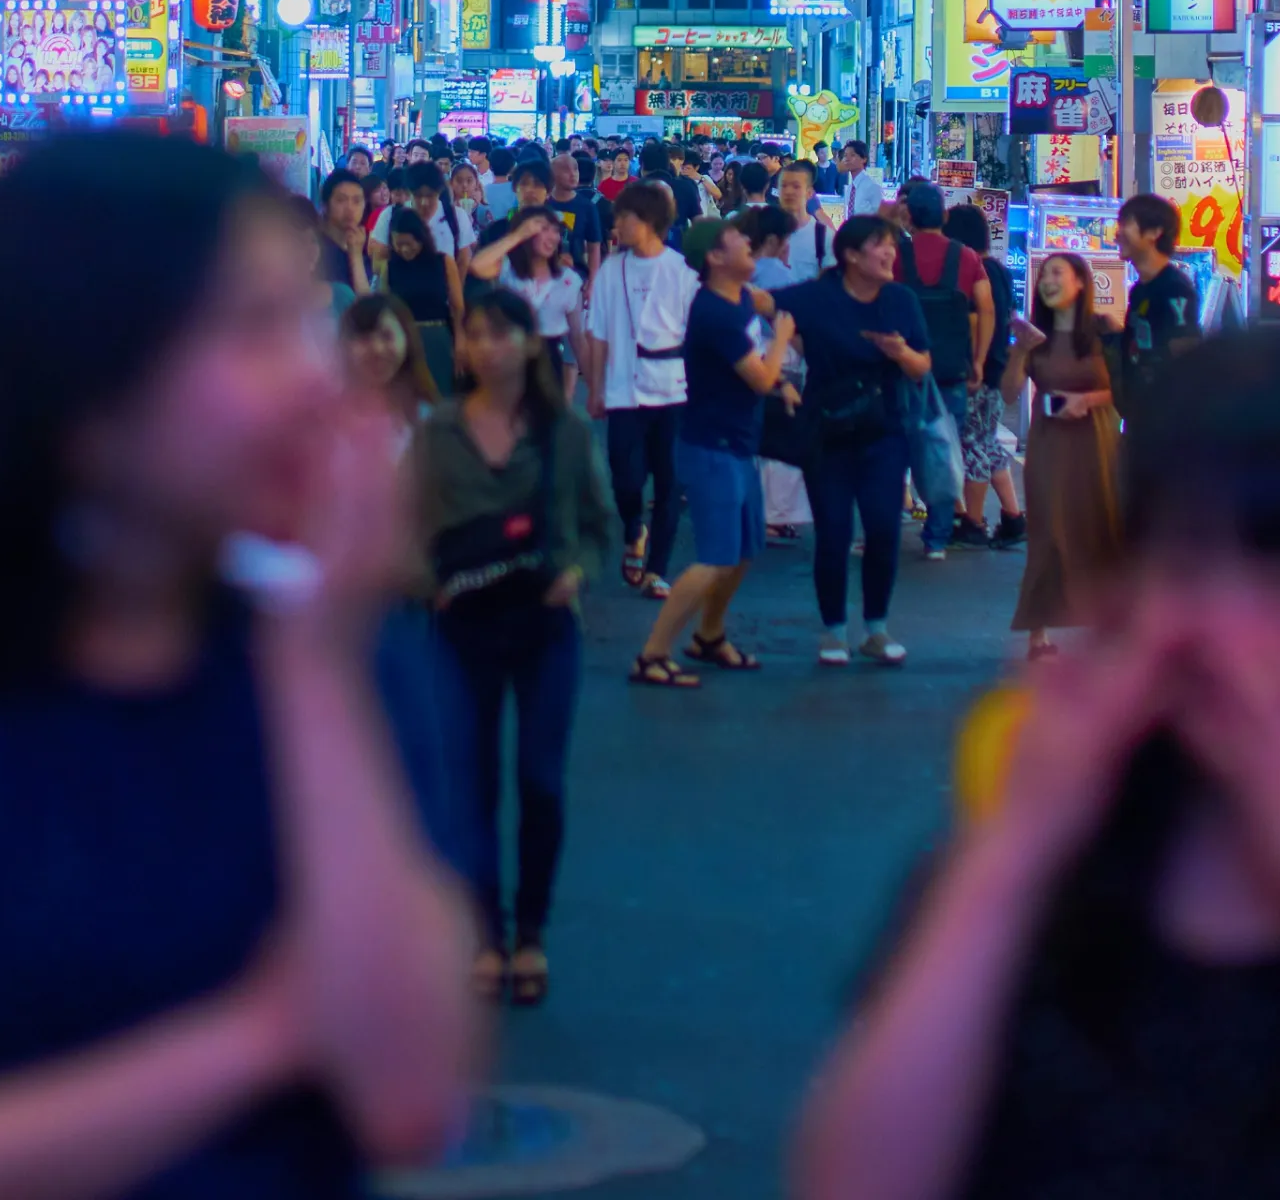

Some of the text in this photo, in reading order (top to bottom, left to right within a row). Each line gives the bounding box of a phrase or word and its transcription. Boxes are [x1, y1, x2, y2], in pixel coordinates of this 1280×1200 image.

[493, 89, 534, 104] ゲーム
[980, 87, 1000, 98] B1
[647, 91, 749, 110] 無料案内所
